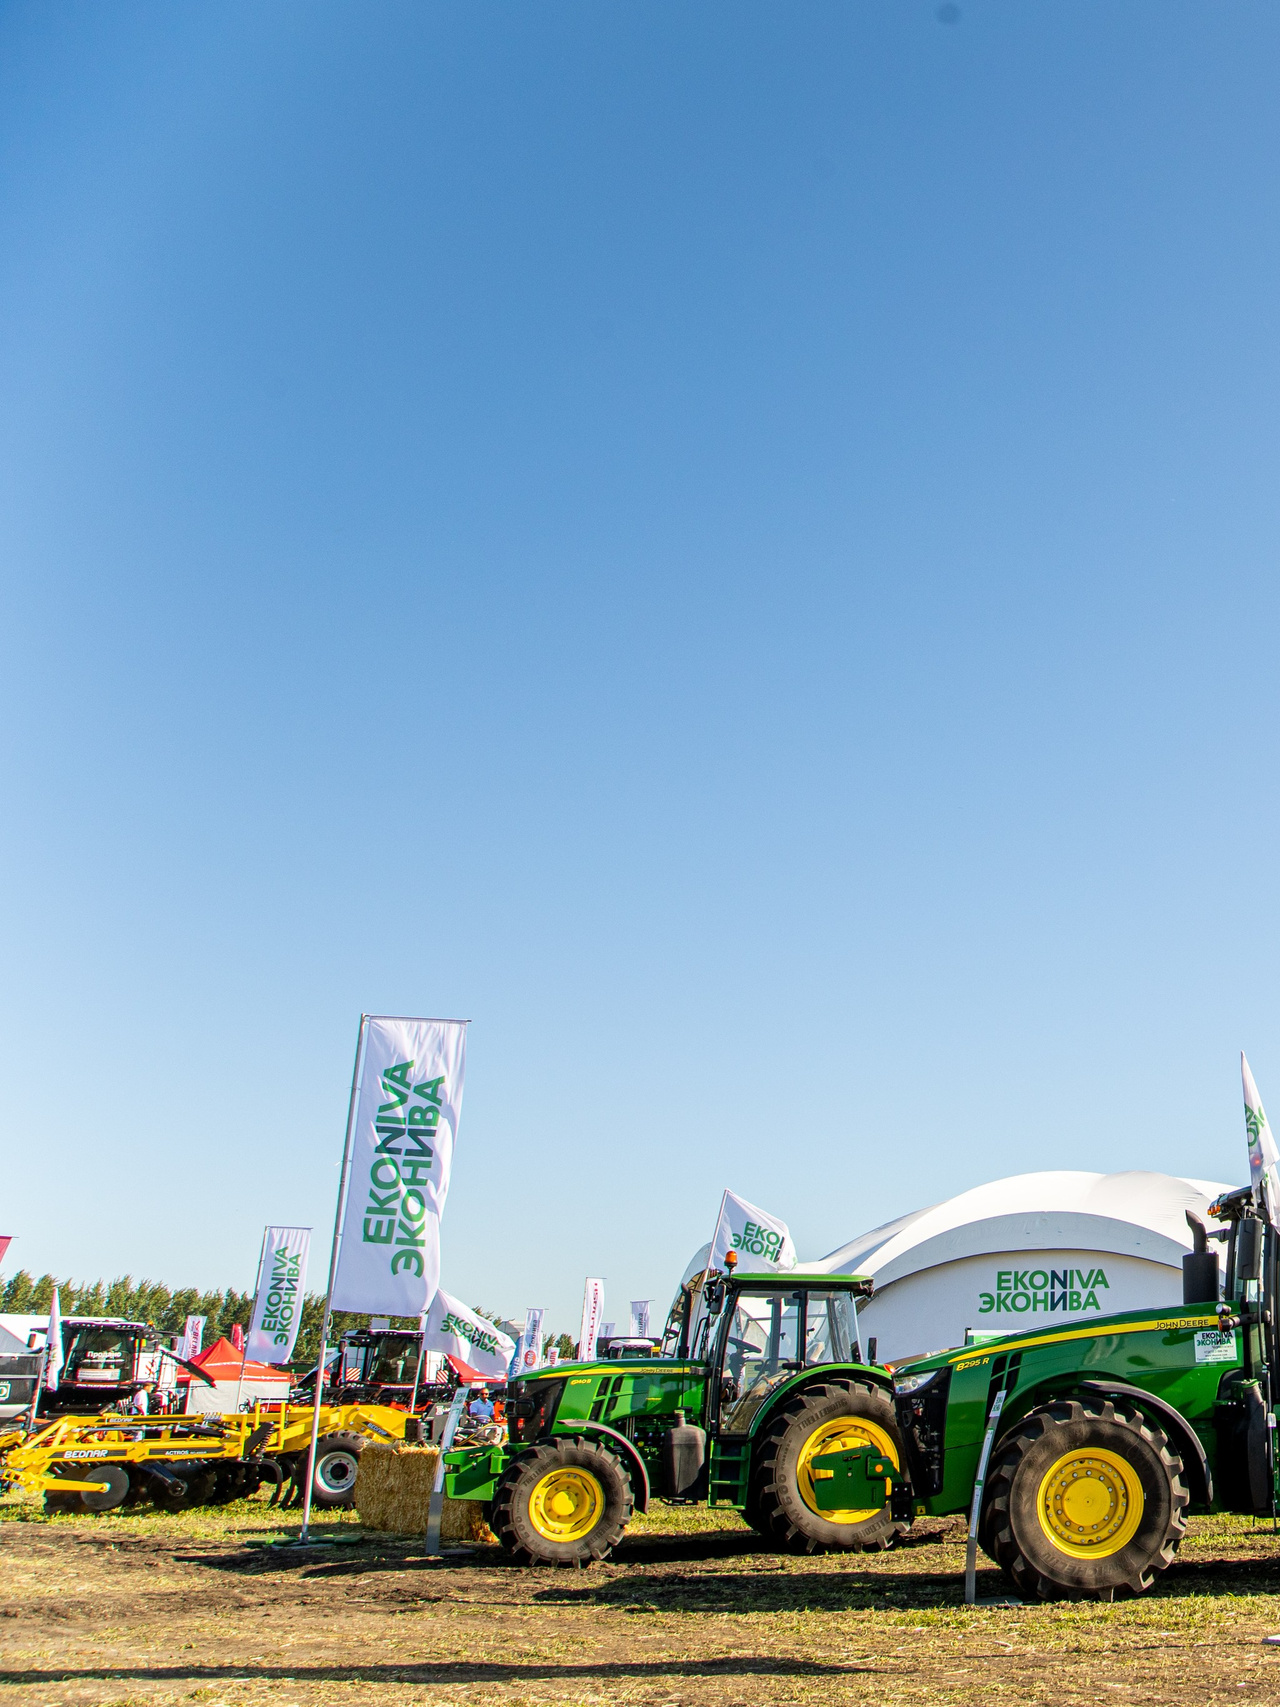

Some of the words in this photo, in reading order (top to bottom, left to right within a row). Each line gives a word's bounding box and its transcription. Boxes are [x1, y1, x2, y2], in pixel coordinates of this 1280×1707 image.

[363, 1059, 415, 1245] EKONIVA
[390, 1075, 446, 1279] ЭКОНИВА
[260, 1245, 289, 1332] EKONIVA
[996, 1268, 1110, 1291] EKONIVA
[273, 1253, 302, 1346] ЭКОНИВА
[978, 1290, 1101, 1314] ЭКОНИВА
[1154, 1321, 1179, 1331] JOHN
[1179, 1319, 1210, 1328] DEERE
[955, 1359, 981, 1372] 8295
[982, 1357, 990, 1365] R
[64, 1449, 108, 1459] BEDNAR
